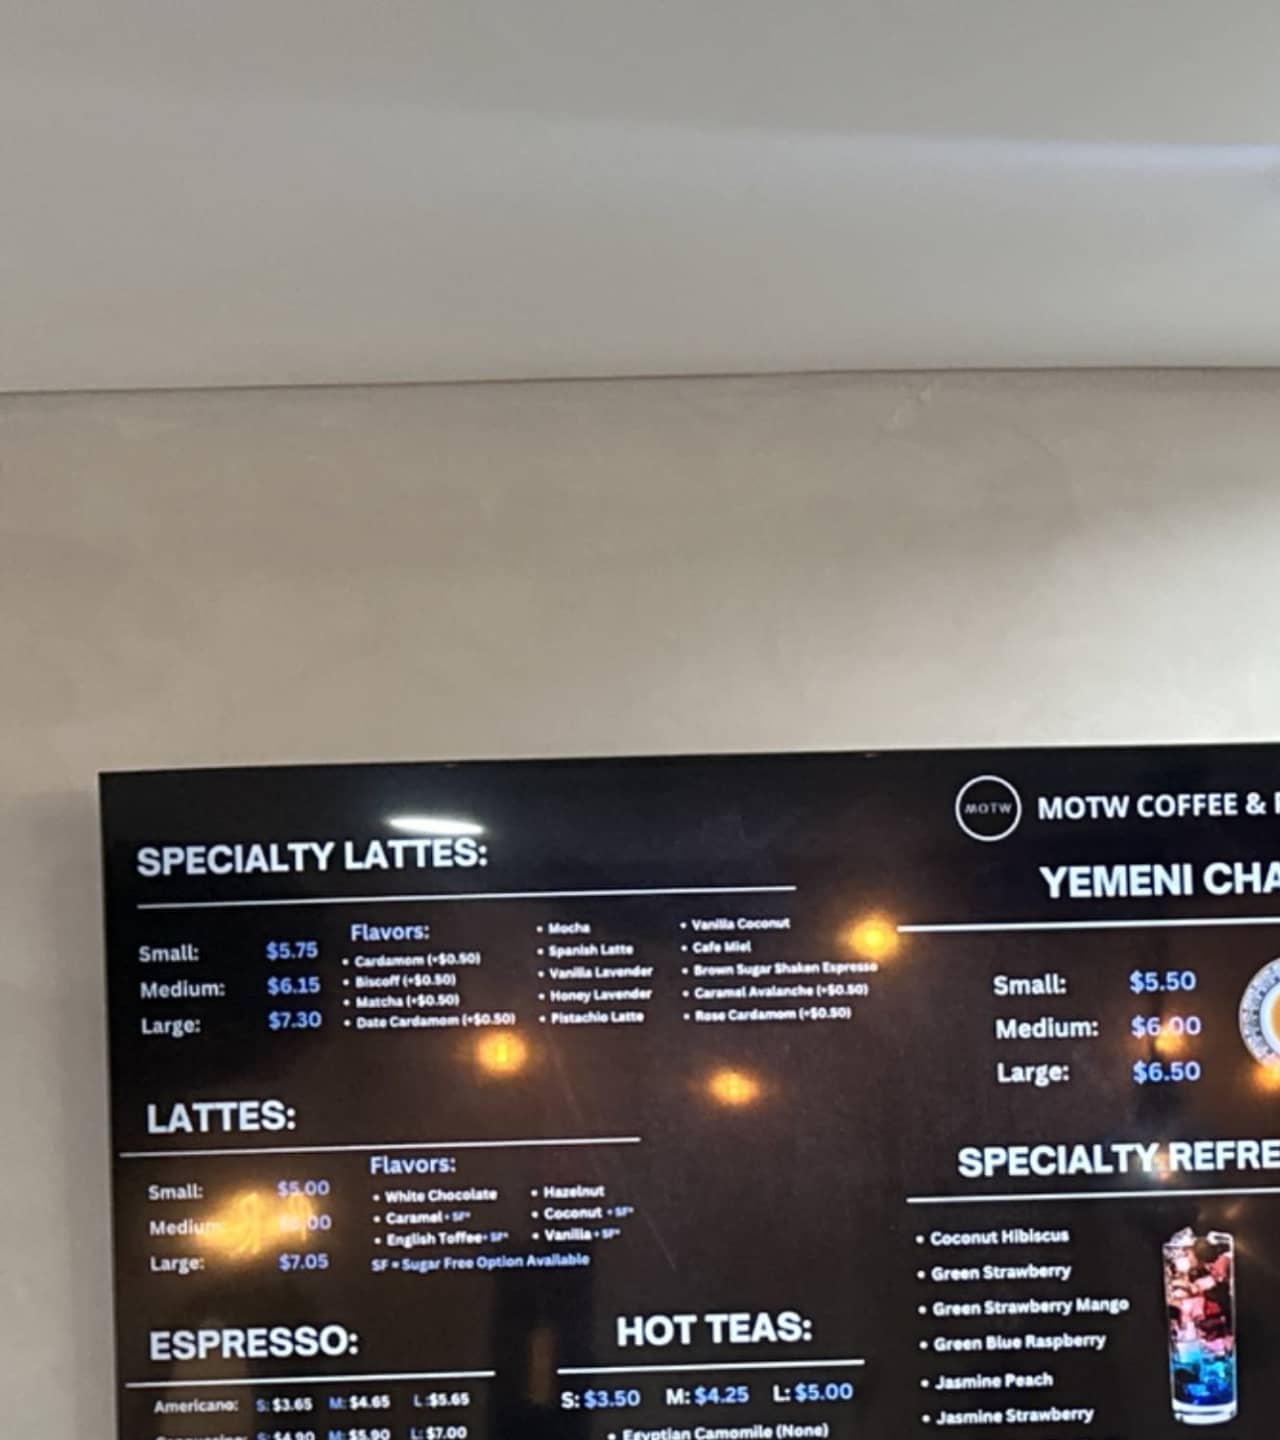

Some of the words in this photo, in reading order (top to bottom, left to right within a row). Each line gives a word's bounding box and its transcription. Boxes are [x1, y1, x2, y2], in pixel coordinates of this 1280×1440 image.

[965, 802, 1013, 815] MOTW
[1038, 796, 1130, 820] MOTW
[1137, 794, 1238, 817] COFFEE
[1246, 794, 1266, 814] &
[137, 842, 334, 877] SPECIALTY
[344, 837, 488, 870] LATTES:
[1040, 865, 1193, 898] YEMENI
[351, 924, 430, 941] Flavors:
[548, 923, 590, 934] Mocha
[139, 942, 200, 963] Small:
[266, 940, 319, 960] $5.75
[549, 946, 598, 958] Spanish
[601, 945, 633, 956] Latte
[140, 978, 225, 999] Medium:
[267, 974, 320, 997] $6.15
[993, 973, 1067, 996] Small:
[1129, 970, 1196, 993] $5.50
[142, 1015, 201, 1038] Large:
[268, 1010, 322, 1032] $7.30
[551, 1011, 608, 1024] Pistachio
[611, 1011, 644, 1023] Latte
[995, 1017, 1099, 1040] Medium:
[997, 1062, 1069, 1085] Large:
[1133, 1060, 1200, 1083] $6.50
[147, 1101, 296, 1135] LATTES:
[370, 1156, 457, 1175] Flavors:
[958, 1143, 1159, 1178] SPECIALTY
[148, 1183, 203, 1200] Small:
[930, 1229, 998, 1247] Coconut
[1001, 1228, 1069, 1245] Hibiscus
[151, 1254, 205, 1273] Large:
[279, 1253, 329, 1272] $7.05
[933, 1302, 981, 1318] Green
[984, 1298, 1073, 1316] Strawberry
[1076, 1297, 1130, 1315] Mango
[616, 1316, 697, 1347] HOT
[705, 1312, 812, 1344] TEAS:
[150, 1325, 359, 1361] ESPRESSO:
[935, 1374, 1001, 1391] Jasmine
[1005, 1373, 1053, 1388] Peach
[154, 1399, 239, 1413] Americano:
[561, 1392, 580, 1409] S:
[584, 1389, 640, 1409] $3.50
[666, 1388, 691, 1405] M:
[695, 1386, 749, 1406] $4.25
[773, 1385, 791, 1401] L:
[794, 1383, 853, 1401] $5.00
[936, 1409, 1002, 1426] Jasmine
[1006, 1406, 1094, 1426] Strawberry
[694, 1426, 772, 1440] Camomile
[776, 1423, 829, 1439] (None)
